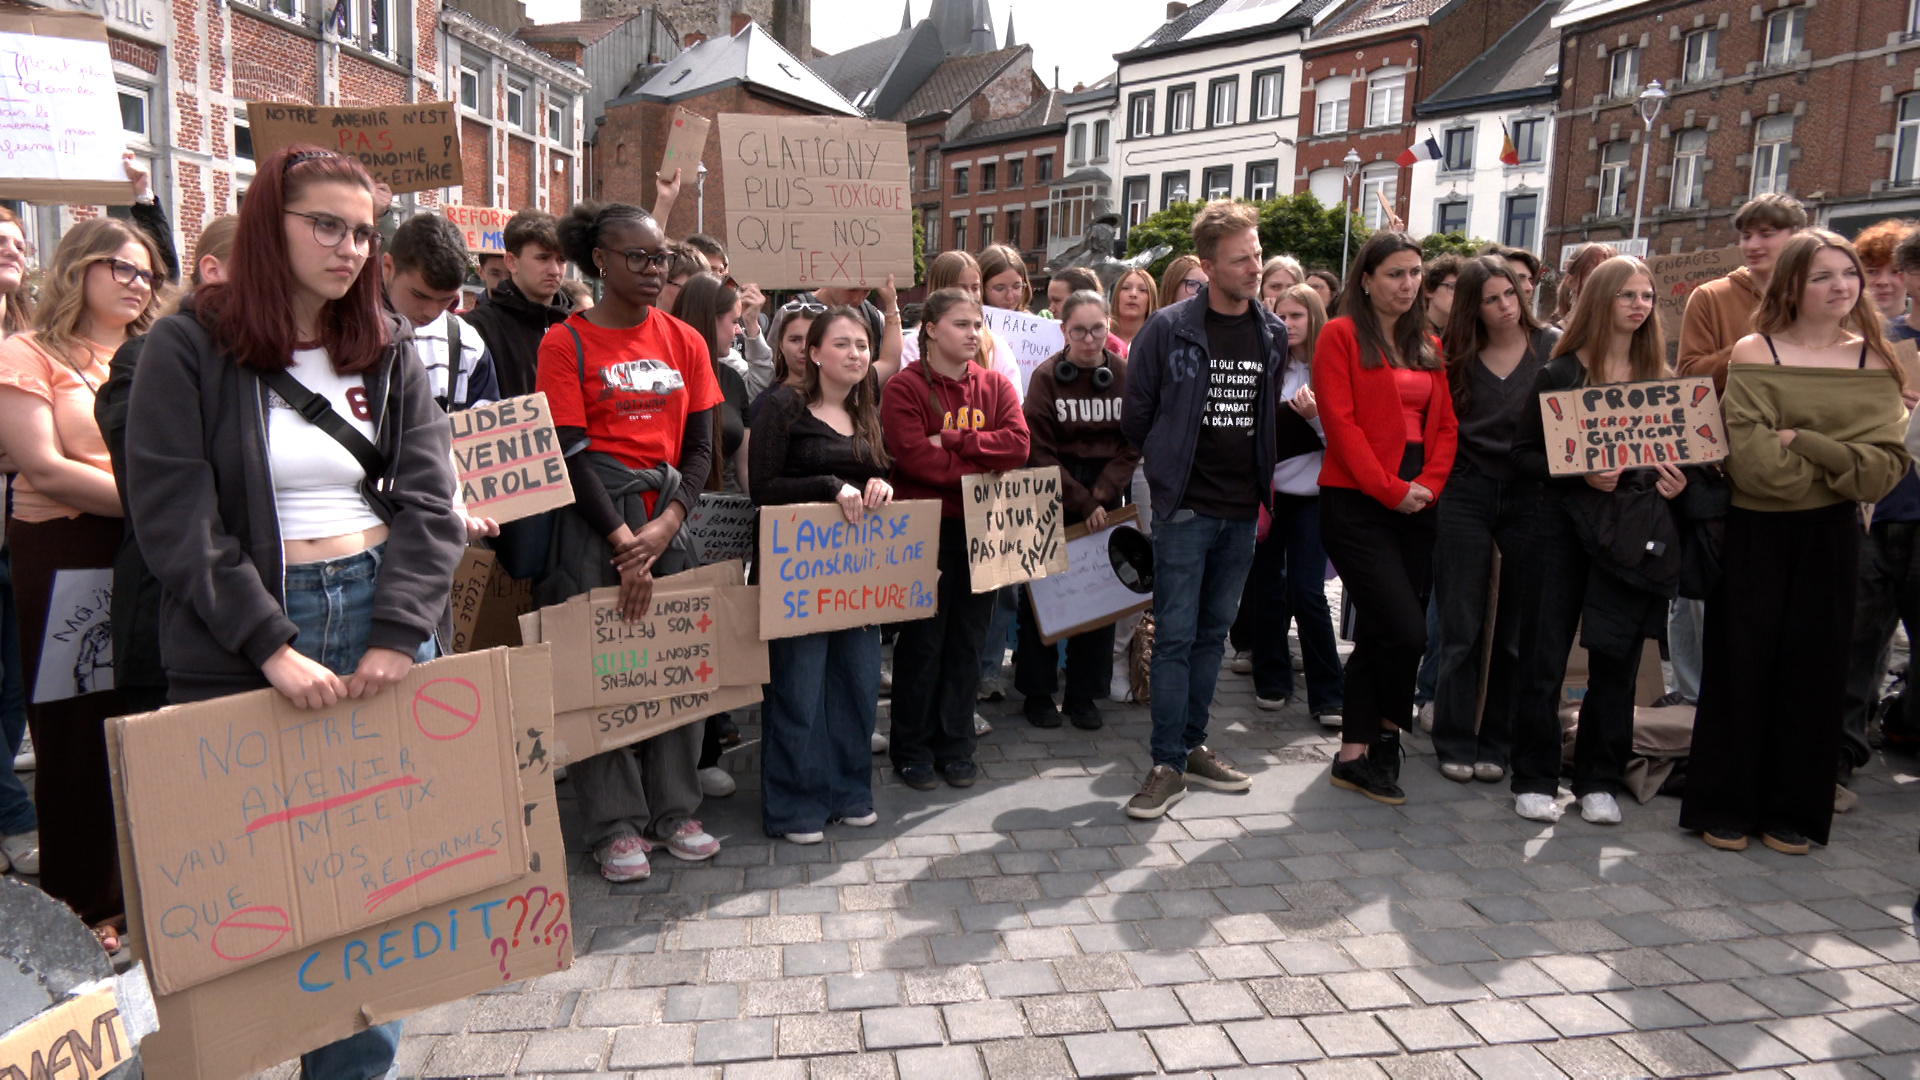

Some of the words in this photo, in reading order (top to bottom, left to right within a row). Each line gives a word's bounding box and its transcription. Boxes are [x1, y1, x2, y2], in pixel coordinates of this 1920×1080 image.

[265, 107, 318, 125] NOTRE
[331, 111, 389, 128] AVENIR
[403, 109, 448, 126] N'EST
[337, 129, 394, 151] PAS
[358, 147, 427, 167] ONOMIE
[373, 163, 452, 186] GETAIRE
[744, 176, 814, 209] PLUS
[737, 215, 806, 254] QUE
[833, 217, 881, 247] NOS
[1582, 385, 1681, 412] PROFS
[449, 398, 540, 438] UDES
[1580, 407, 1686, 430] INCROYABLE
[1586, 425, 1686, 446] GLATIGNY
[1585, 438, 1690, 470] PITOYABLE
[463, 457, 563, 503] AROLE
[974, 484, 989, 503] ON
[994, 477, 1031, 499] VEUT
[1033, 478, 1056, 495] UN
[889, 513, 910, 539] SE
[986, 507, 1033, 531] FUTUR
[1020, 490, 1062, 577] FACTURE
[970, 537, 996, 563] PAS
[999, 539, 1023, 555] UNE
[595, 607, 624, 626] ENS
[654, 597, 711, 616] SERONT
[783, 589, 810, 620] SE
[667, 617, 695, 635] VOS
[655, 643, 711, 662] SERONT
[601, 670, 657, 691] MOYENS
[663, 666, 694, 687] VOS
[597, 700, 661, 732] GLOSS
[670, 692, 709, 716] MON
[200, 705, 381, 780] NOTRE
[242, 748, 416, 823] AVENIR
[160, 831, 259, 887] VAUT
[298, 779, 435, 843] MIEUX
[160, 886, 252, 942] QUE
[303, 844, 367, 885] VOS
